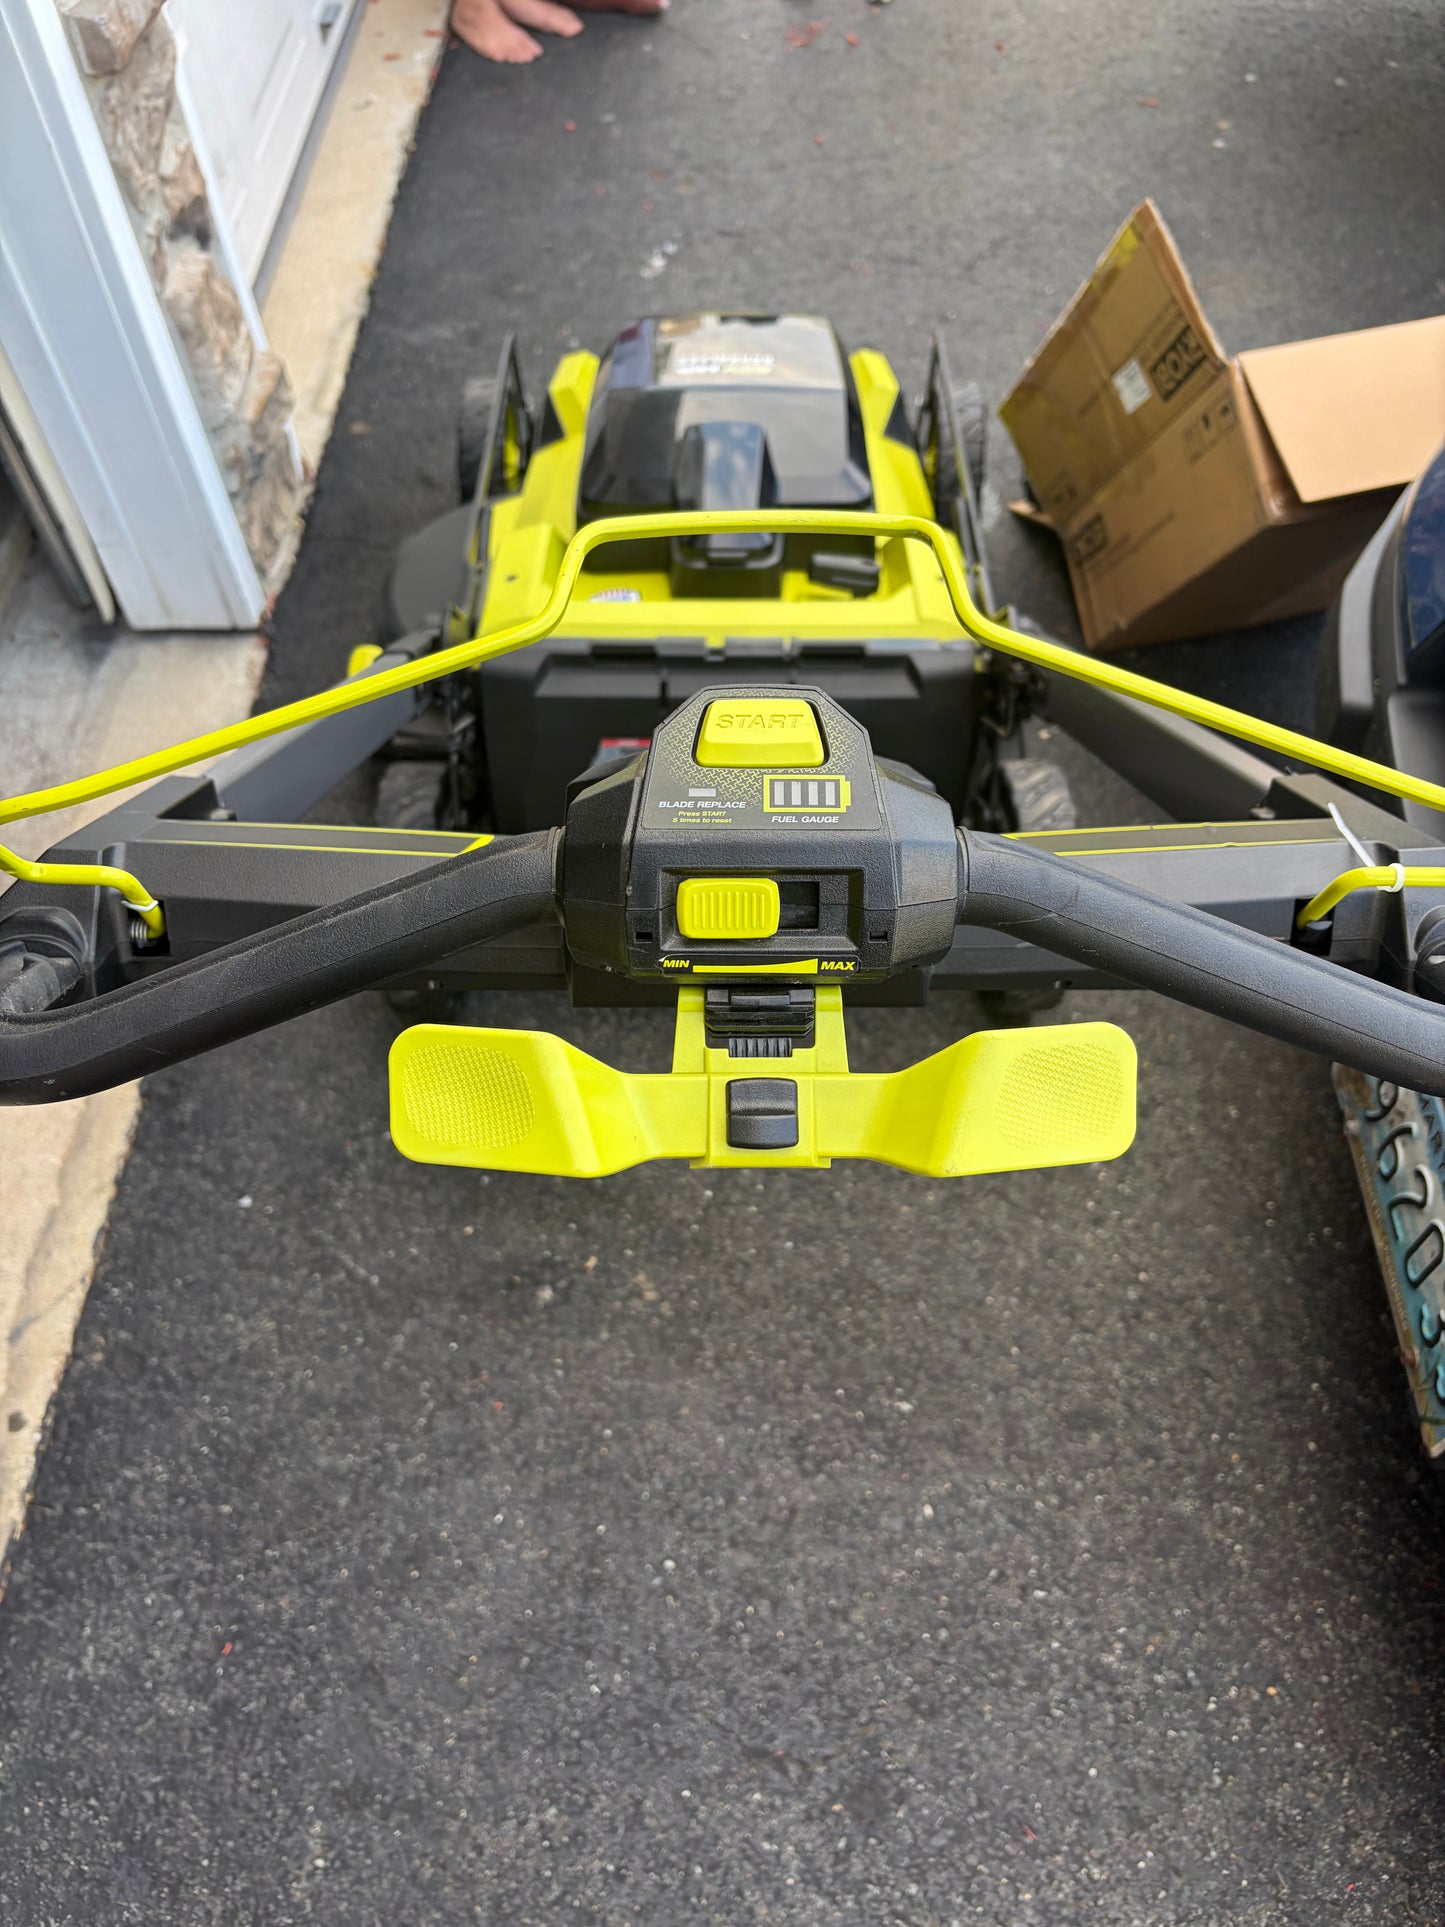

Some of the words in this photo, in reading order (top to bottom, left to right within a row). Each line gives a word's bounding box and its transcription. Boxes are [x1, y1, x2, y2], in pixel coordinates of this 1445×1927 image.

[715, 714, 804, 729] START
[696, 801, 747, 809] REPLACE
[771, 815, 798, 823] FUEL
[801, 815, 840, 823] GAUGE
[662, 959, 690, 968] MIN
[820, 961, 856, 971] MAX
